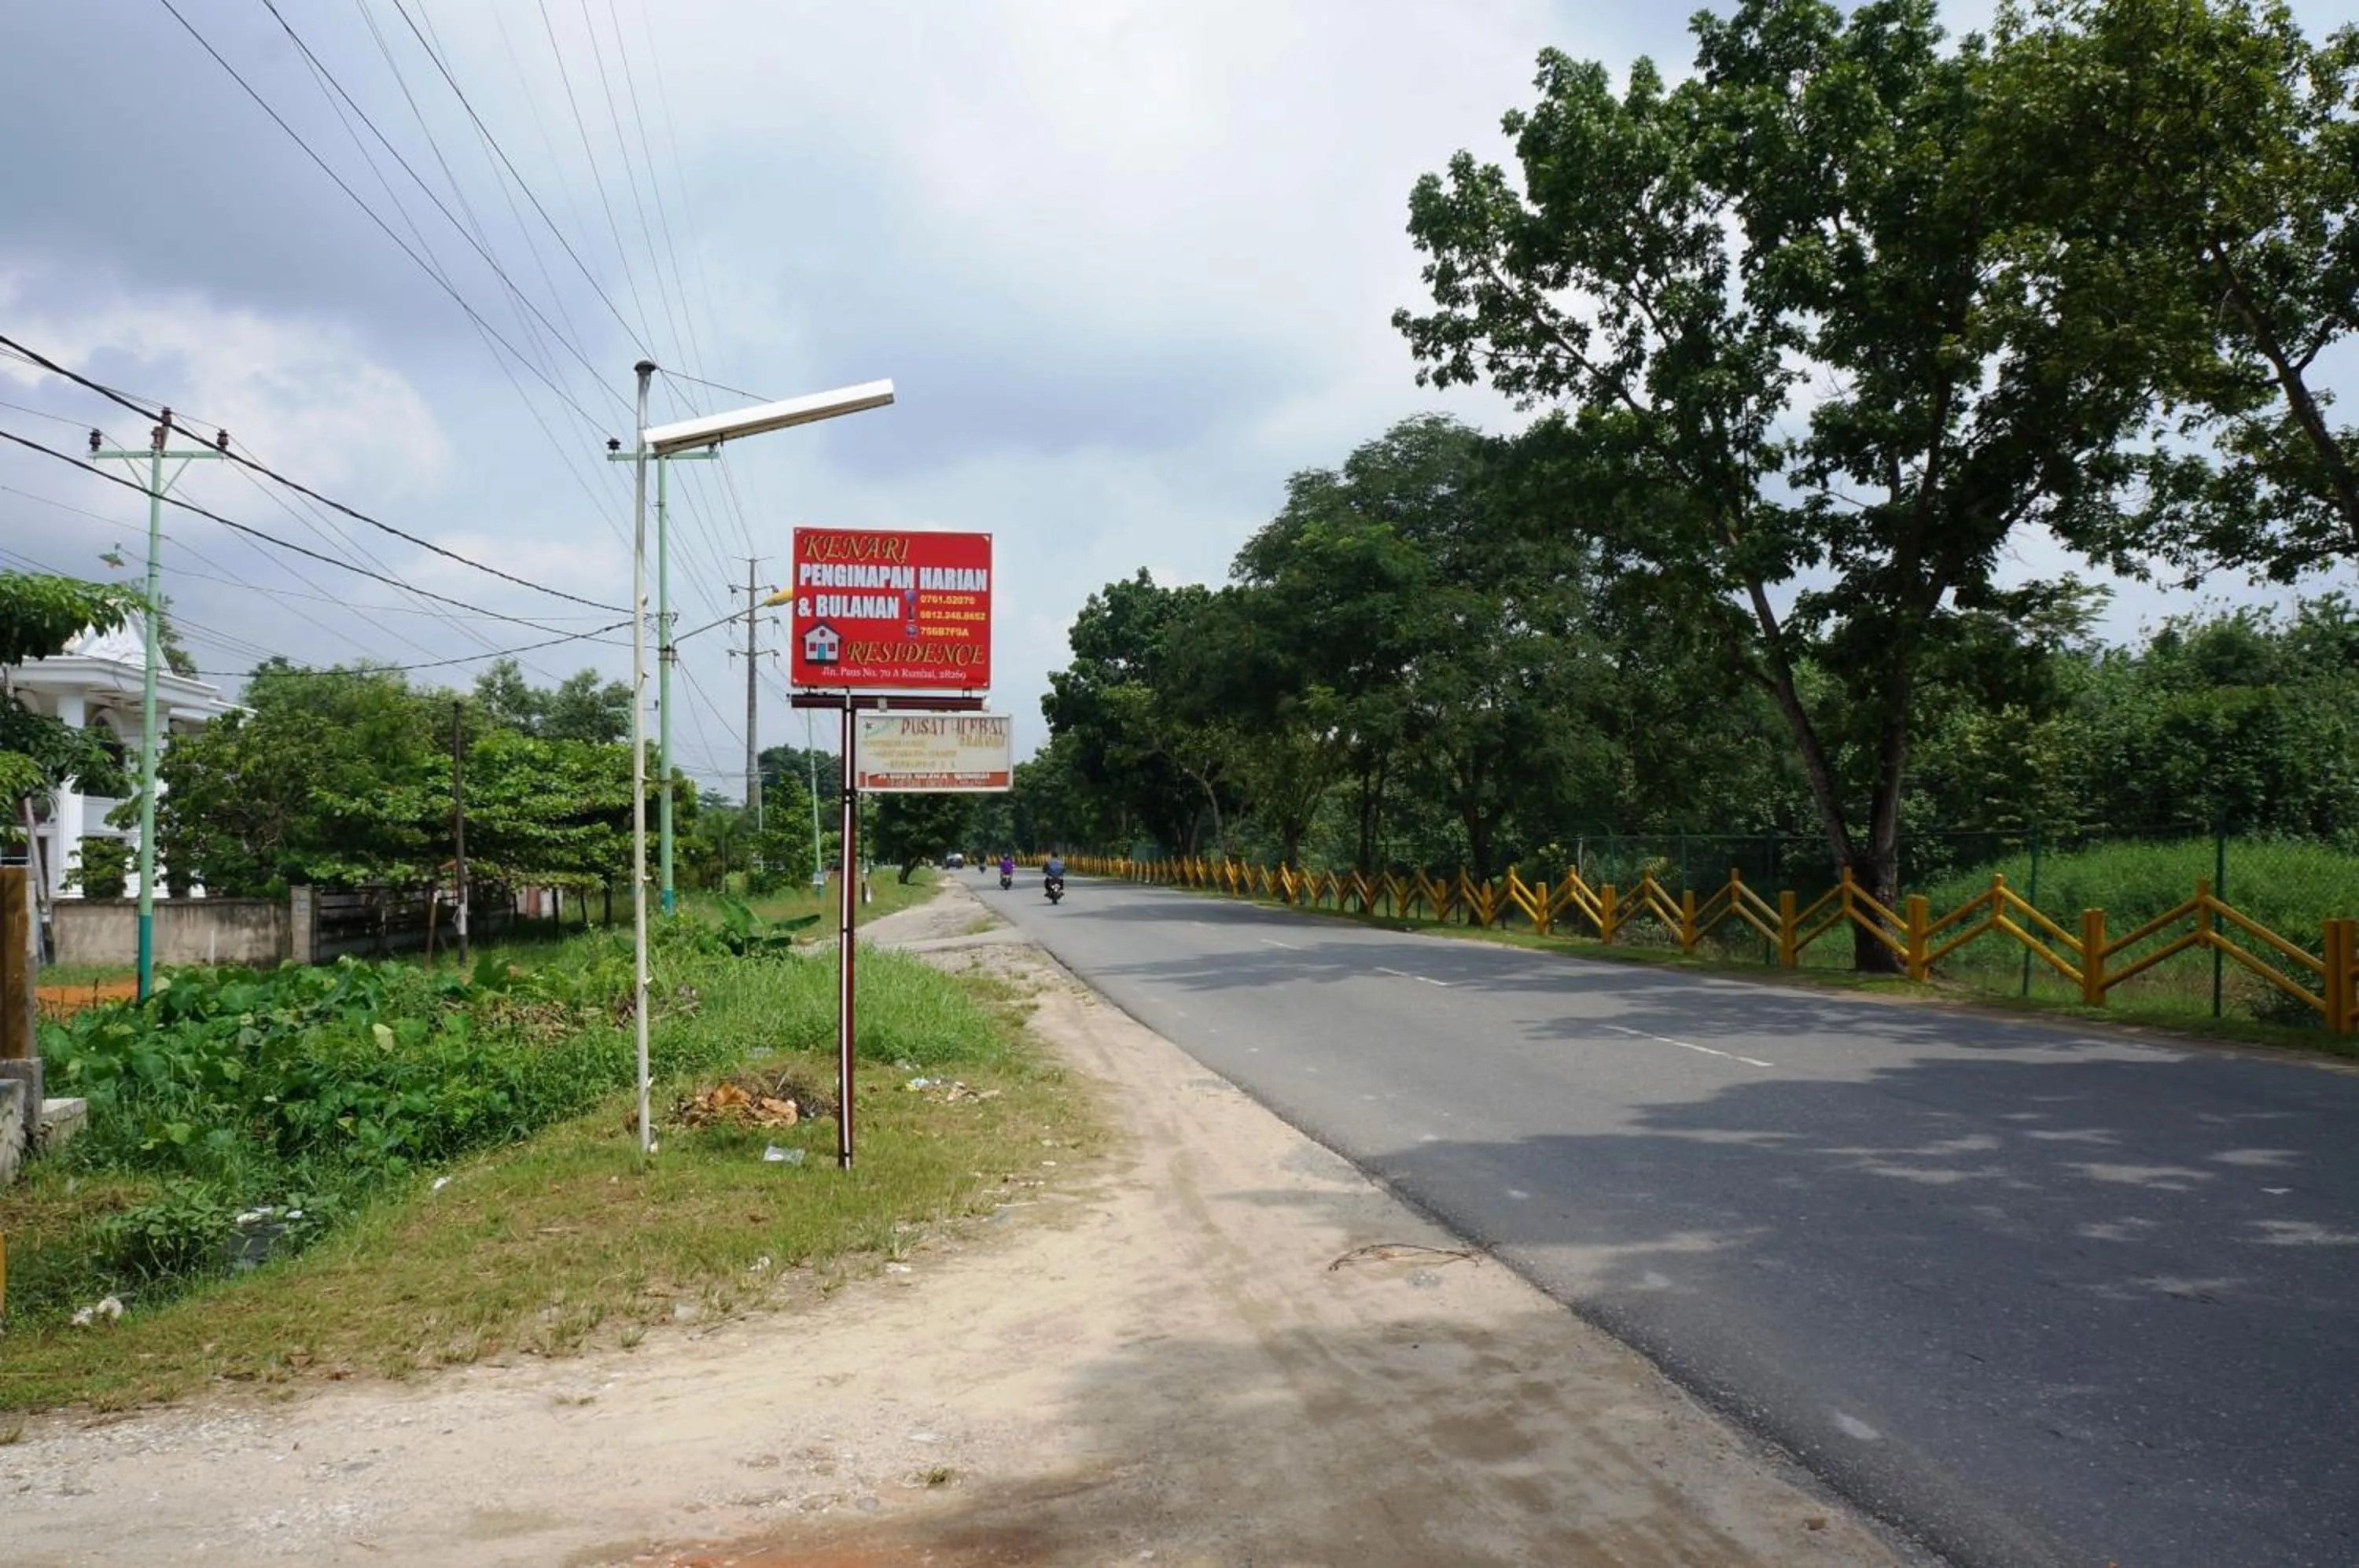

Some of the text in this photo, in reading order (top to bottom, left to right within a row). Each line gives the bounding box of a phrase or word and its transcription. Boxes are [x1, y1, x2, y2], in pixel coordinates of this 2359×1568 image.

[803, 535, 909, 565] KENARI
[799, 562, 988, 591] PENGINAPAN HARIAN
[797, 594, 900, 620] & BULANAN
[847, 642, 985, 666] RESIDENCE
[900, 716, 944, 735] PUSAT
